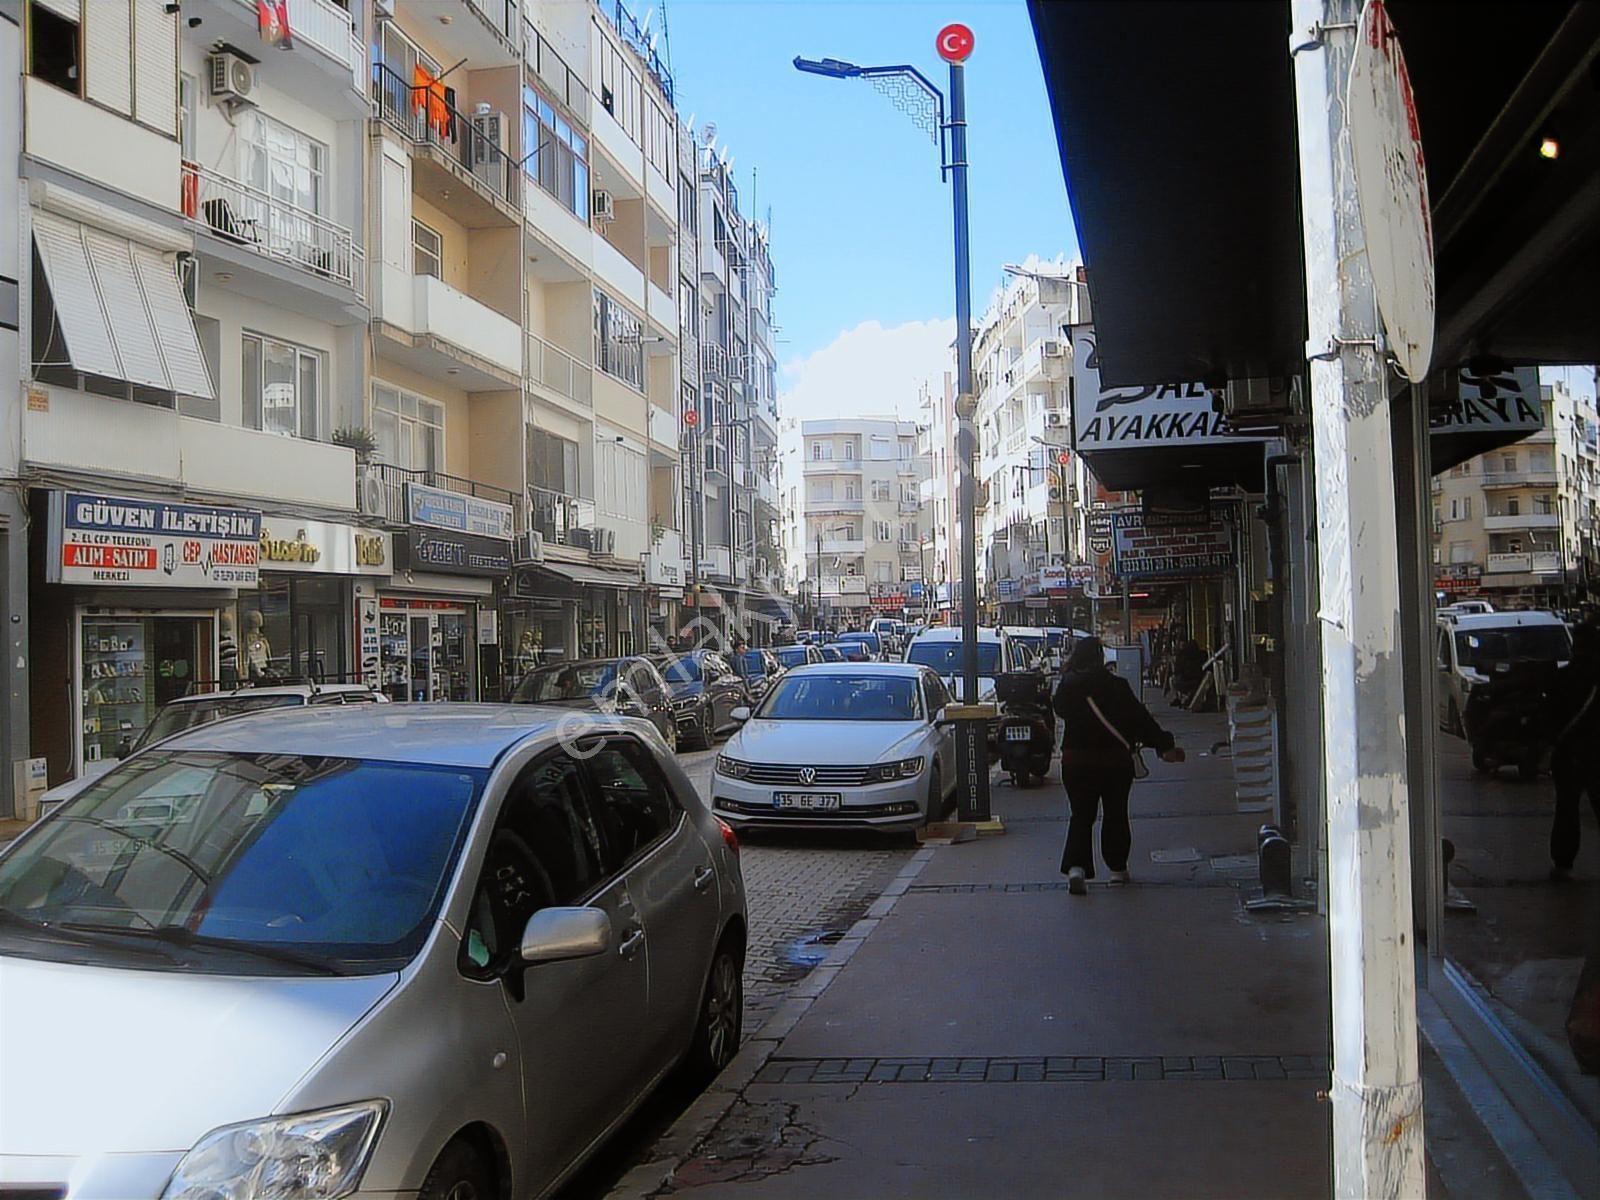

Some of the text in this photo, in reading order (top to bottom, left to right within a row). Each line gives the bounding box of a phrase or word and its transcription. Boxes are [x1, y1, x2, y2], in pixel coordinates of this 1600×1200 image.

[77, 500, 253, 538] GÜVEN İLETİŞİM
[73, 547, 103, 565] ALIM
[112, 548, 148, 567] SATIM
[183, 541, 201, 563] CEP
[93, 569, 130, 582] MERKEZİ
[779, 794, 793, 806] 35
[819, 795, 838, 807] 377
